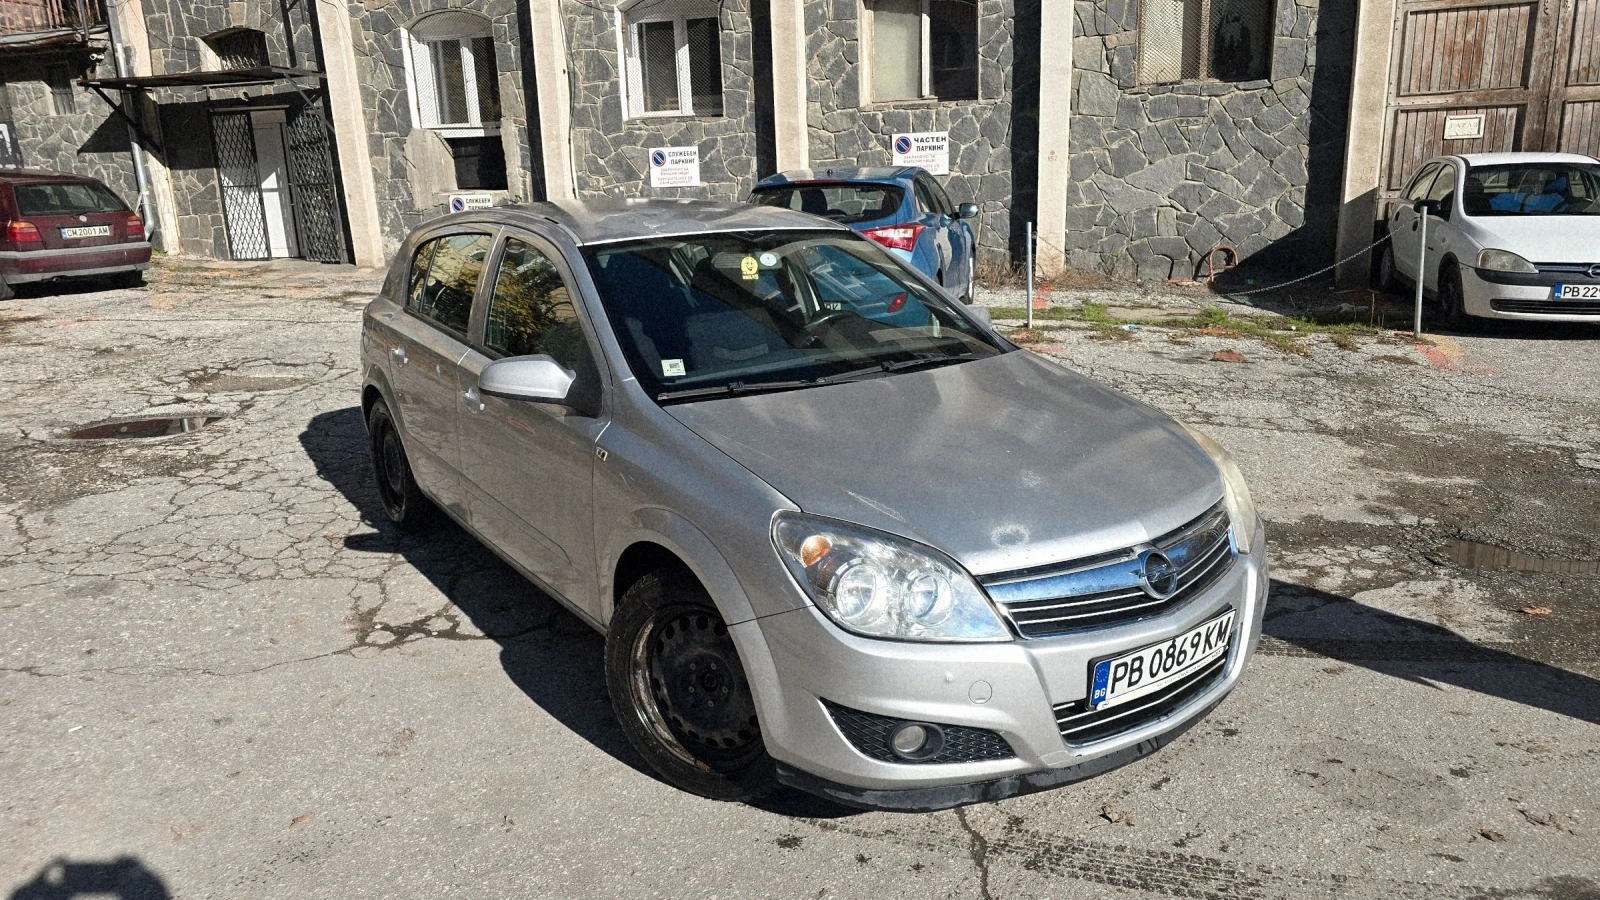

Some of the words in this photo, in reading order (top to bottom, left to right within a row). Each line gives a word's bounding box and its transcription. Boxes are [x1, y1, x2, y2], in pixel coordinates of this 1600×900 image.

[916, 144, 945, 152] ПАРКИНГ
[66, 229, 77, 237] CM
[78, 228, 97, 236] 2001
[98, 226, 109, 235] AM
[1562, 286, 1580, 297] PB
[1581, 286, 1600, 298] 22
[1110, 655, 1144, 695] PB
[1148, 631, 1202, 679] 0869
[1202, 616, 1231, 655] KM
[1093, 687, 1106, 700] BG
